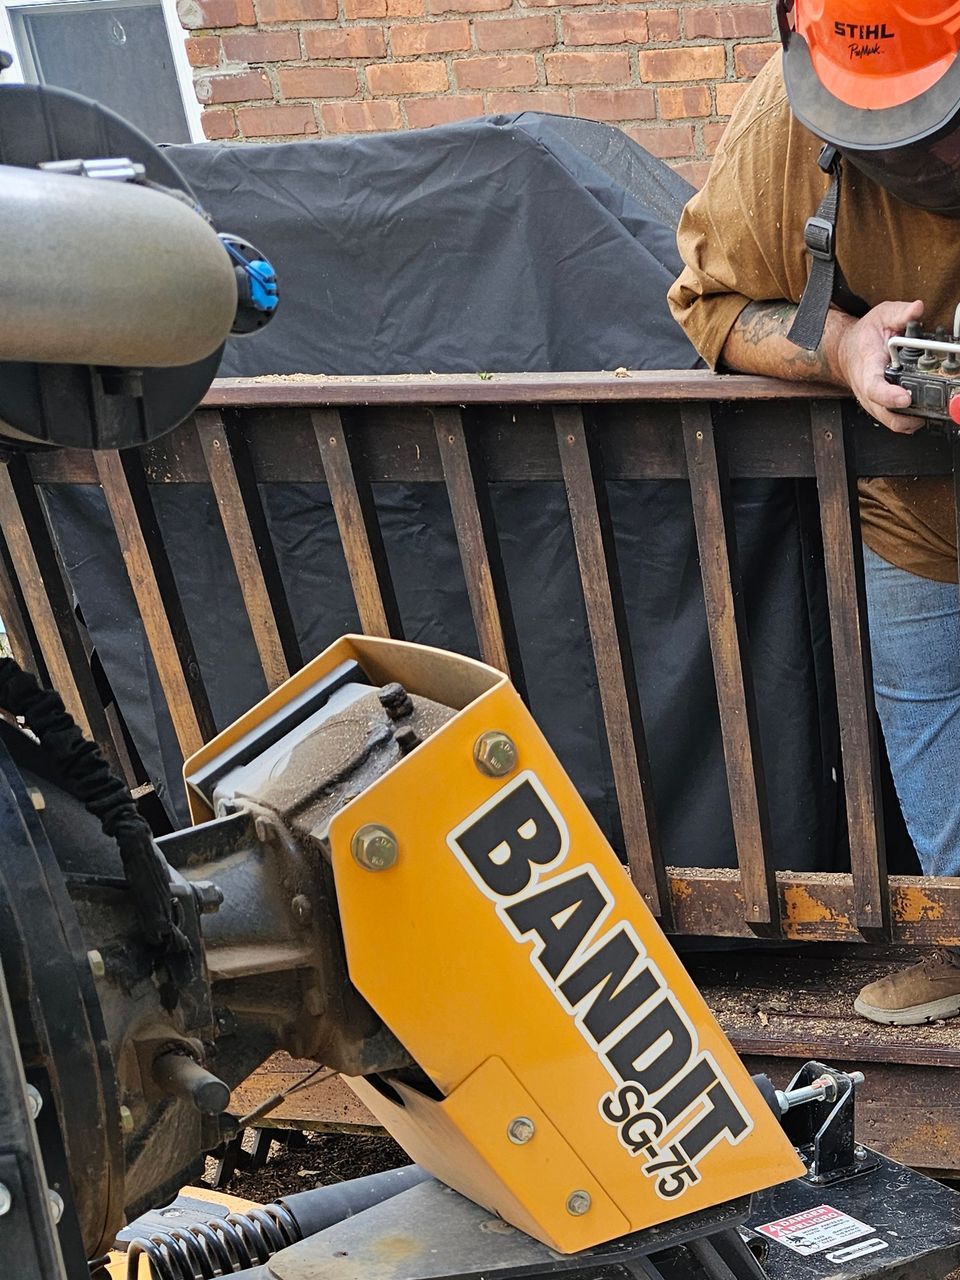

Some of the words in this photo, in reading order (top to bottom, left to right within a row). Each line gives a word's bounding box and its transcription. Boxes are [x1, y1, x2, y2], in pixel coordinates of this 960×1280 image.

[834, 21, 895, 39] STIHL
[455, 780, 748, 1163] BANDIT
[602, 1084, 698, 1197] SG-75
[780, 1207, 830, 1227] DANGER
[787, 1212, 838, 1234] PELIGRO
